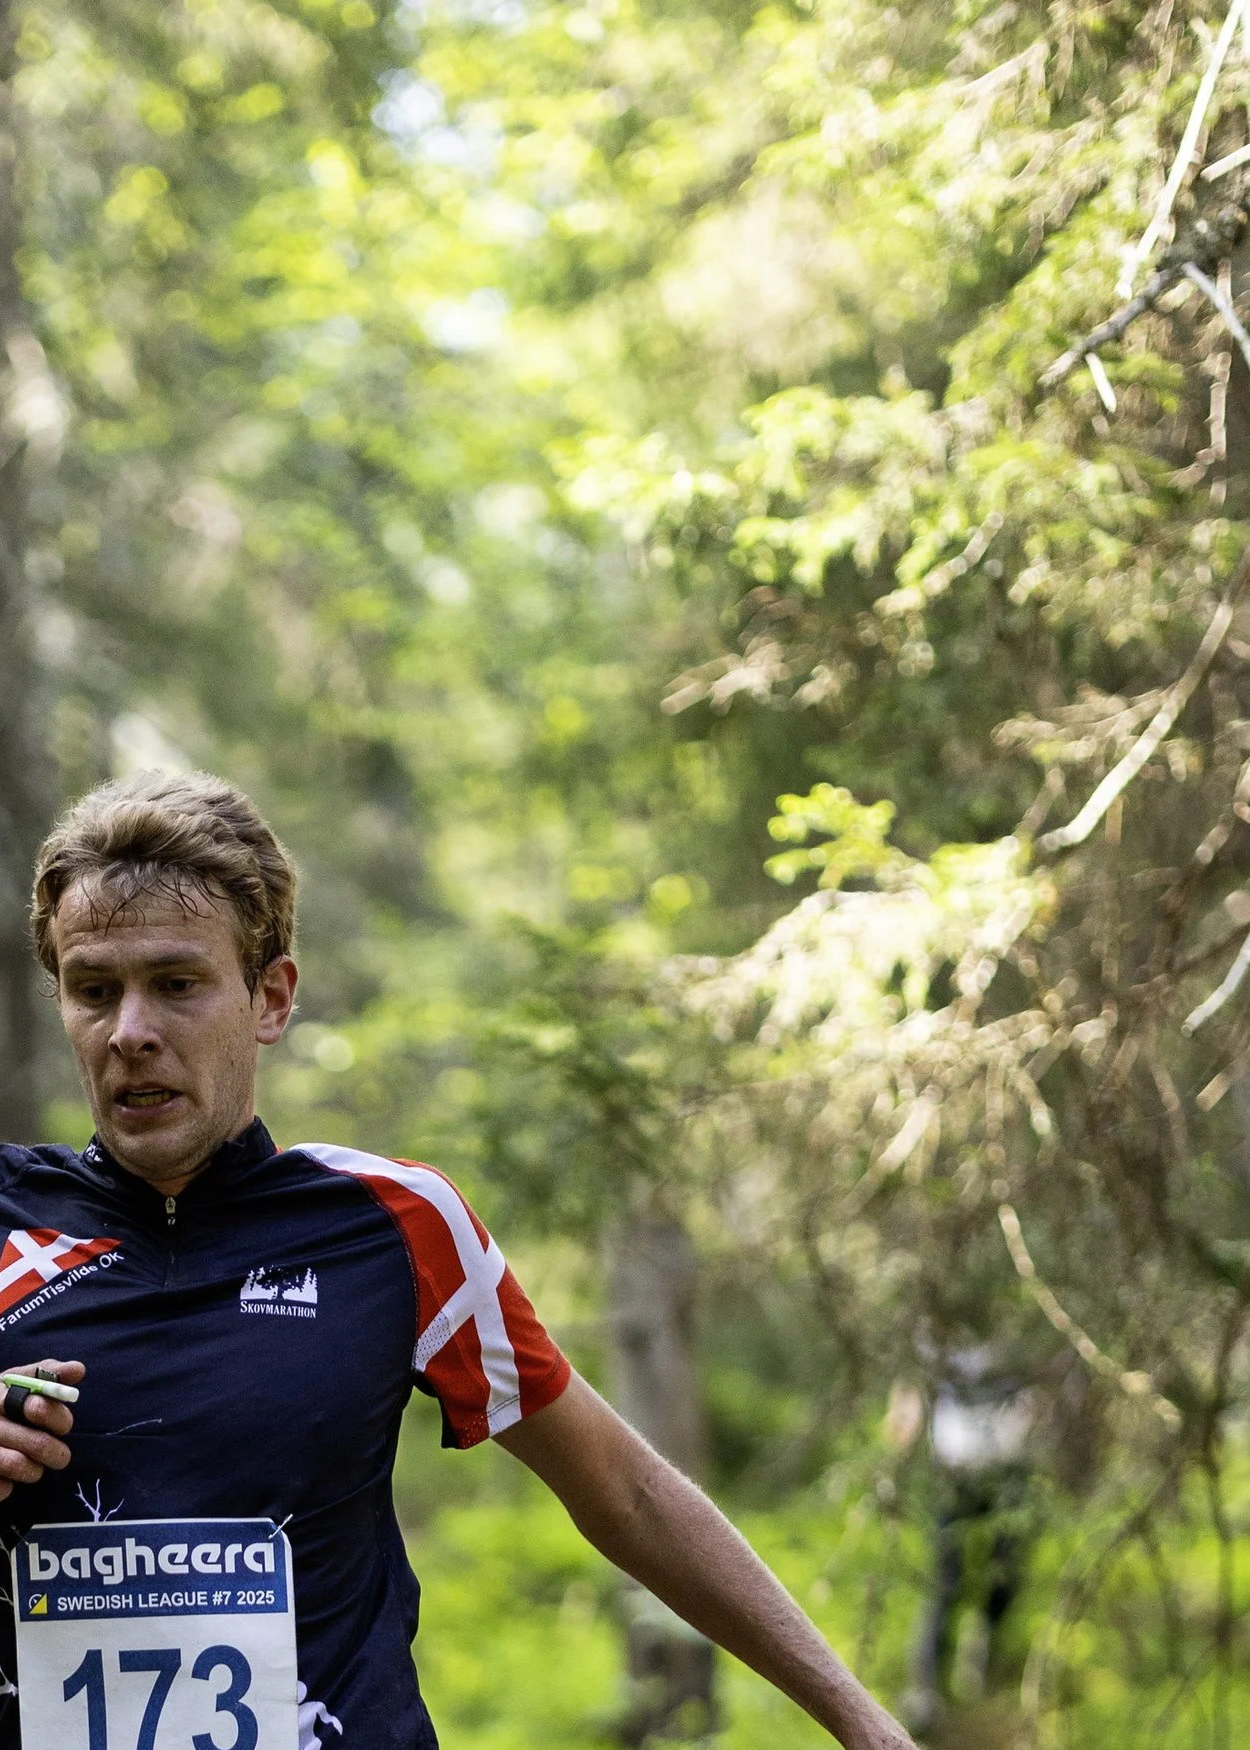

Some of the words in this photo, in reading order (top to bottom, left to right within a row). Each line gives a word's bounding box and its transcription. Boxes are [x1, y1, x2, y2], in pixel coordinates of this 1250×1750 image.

[28, 1537, 276, 1585] bagheera
[57, 1593, 133, 1612] SWEDISH
[138, 1591, 208, 1608] LEAGUE
[212, 1591, 232, 1606] #7
[236, 1590, 275, 1606] 2025
